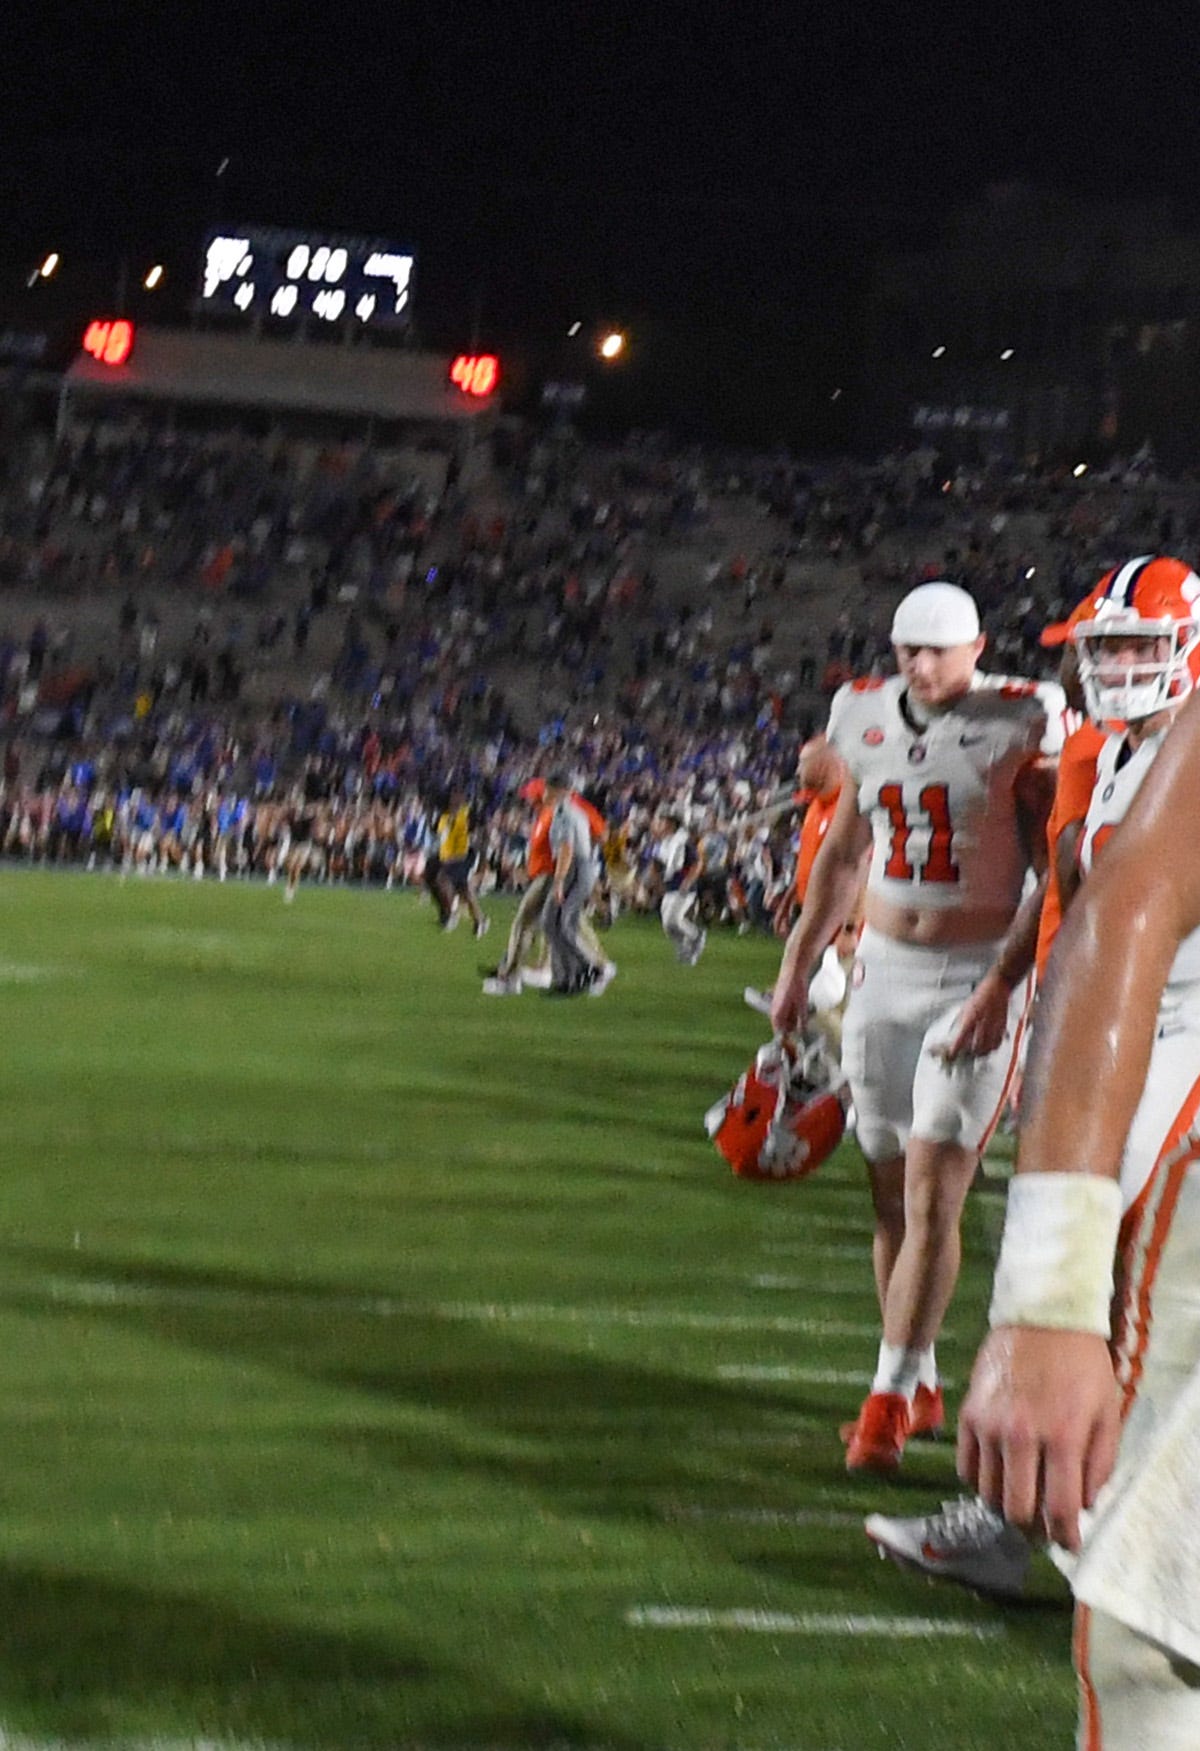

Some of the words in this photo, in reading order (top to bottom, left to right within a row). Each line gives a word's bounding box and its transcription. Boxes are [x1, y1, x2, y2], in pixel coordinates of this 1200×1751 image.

[83, 319, 133, 365] 40
[451, 354, 499, 397] 40
[878, 782, 961, 884] 11
